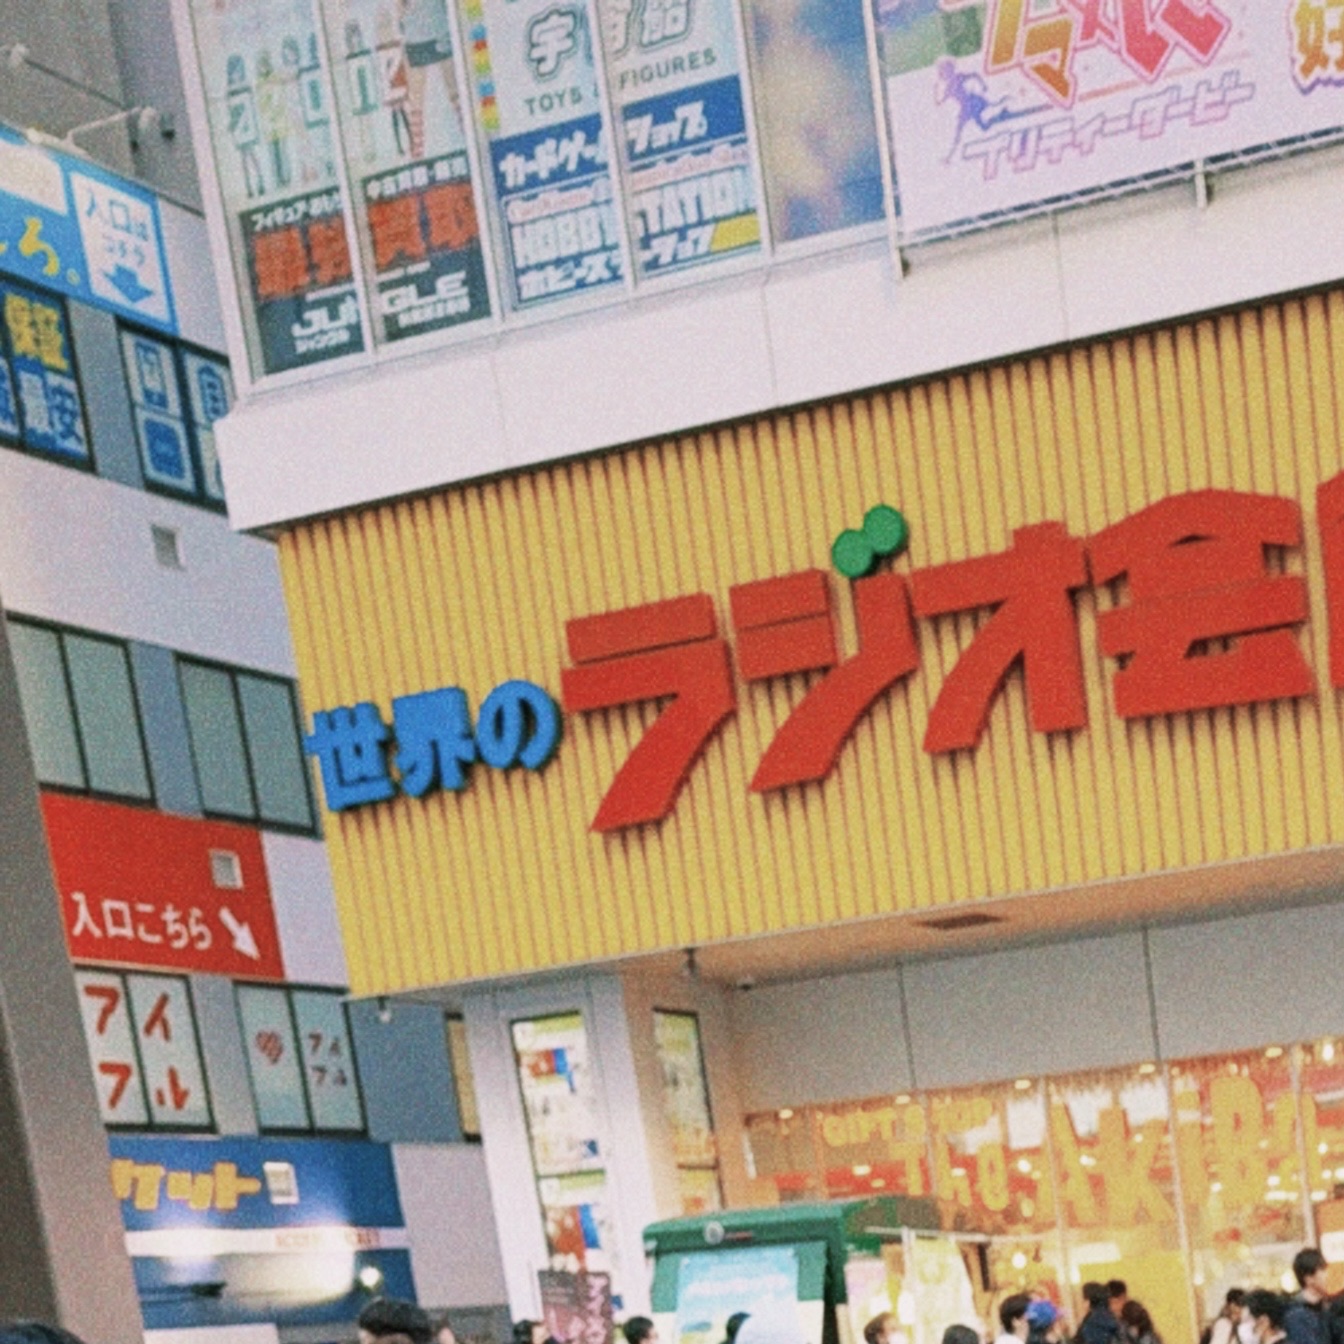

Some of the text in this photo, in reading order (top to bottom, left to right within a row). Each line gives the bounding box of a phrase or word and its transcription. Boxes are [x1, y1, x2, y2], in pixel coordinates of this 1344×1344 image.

[524, 48, 718, 116] TOYS FIGURES
[499, 100, 709, 189] カードゲーショップ
[631, 166, 757, 243] TATION
[305, 678, 563, 811] 世界の
[71, 890, 213, 951] 入口こちら
[84, 984, 171, 1043] アイ
[99, 1062, 190, 1111] フル
